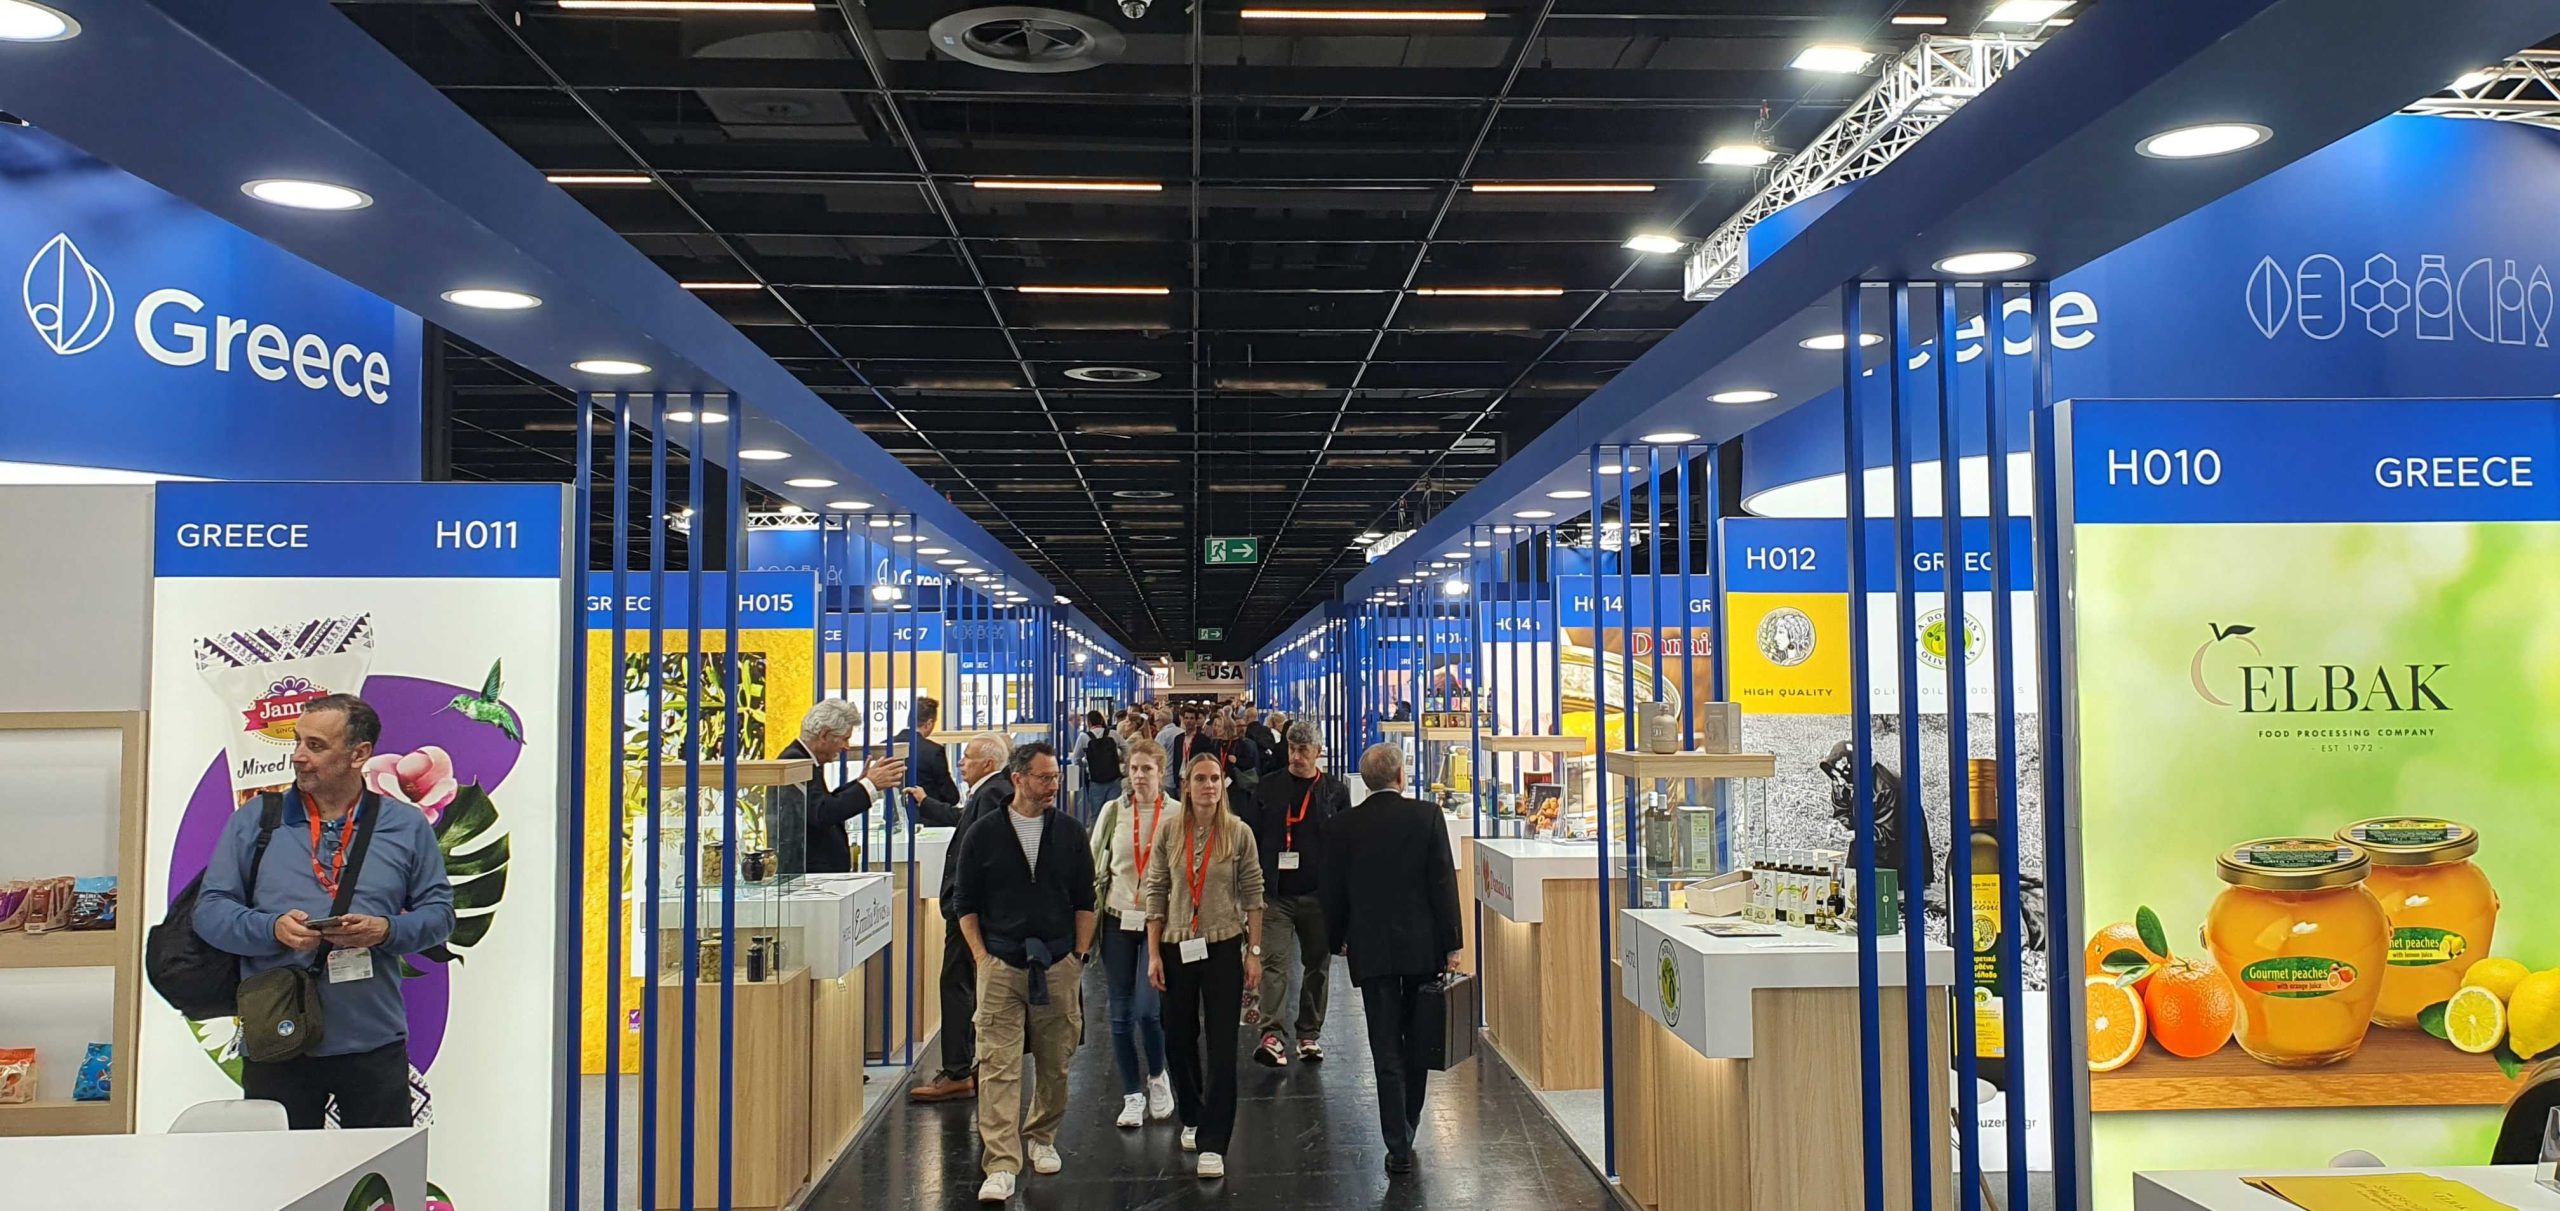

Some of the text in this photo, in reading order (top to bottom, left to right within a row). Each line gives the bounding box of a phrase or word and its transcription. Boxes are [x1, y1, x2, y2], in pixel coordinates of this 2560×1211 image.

[134, 287, 391, 405] Greece
[2107, 449, 2533, 487] H010 GREECE
[176, 520, 518, 549] GREECE H011
[1747, 547, 1992, 572] H012 GREC
[586, 594, 794, 612] GREC H015
[1207, 664, 1243, 680] USA
[1744, 688, 1833, 697] HIGH QUALITY
[2238, 664, 2453, 712] ELBAK
[2258, 728, 2435, 739] FOOD PROCESSING COMPANY
[2321, 743, 2374, 753] EST 1972
[237, 753, 287, 779] Mixed
[2405, 937, 2440, 951] peaches
[2249, 967, 2328, 982] Gourmet peaches
